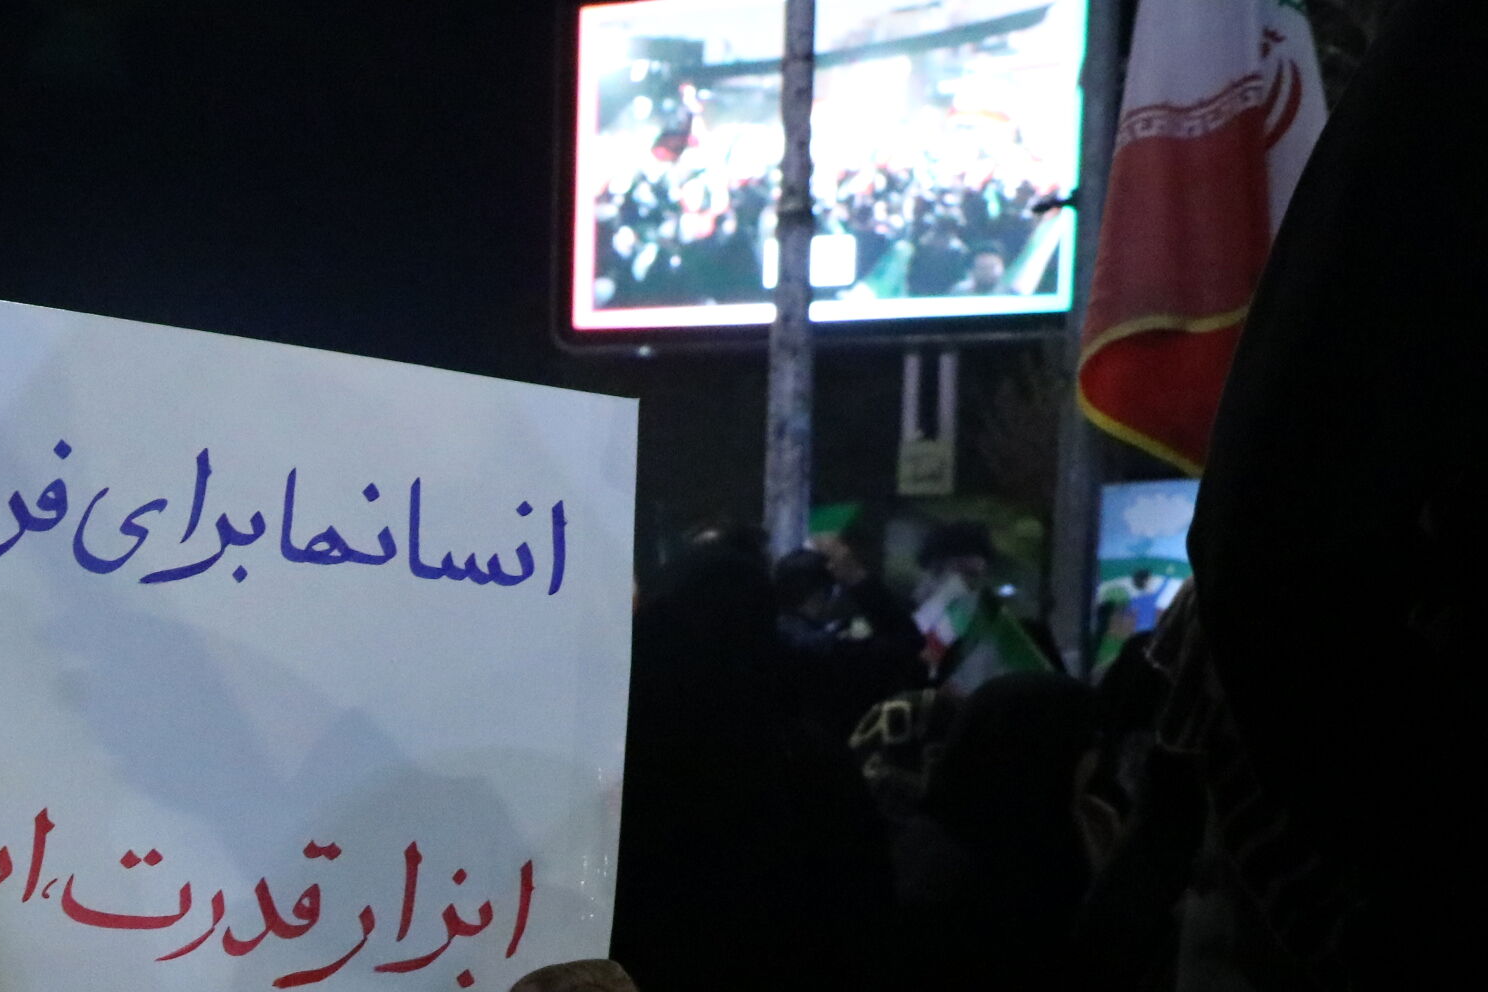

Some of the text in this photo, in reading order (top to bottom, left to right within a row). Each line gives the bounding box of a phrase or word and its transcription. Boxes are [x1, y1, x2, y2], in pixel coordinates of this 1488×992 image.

[71, 446, 268, 585] برای
[279, 467, 569, 597] انسانها
[272, 840, 536, 990] ابزار
